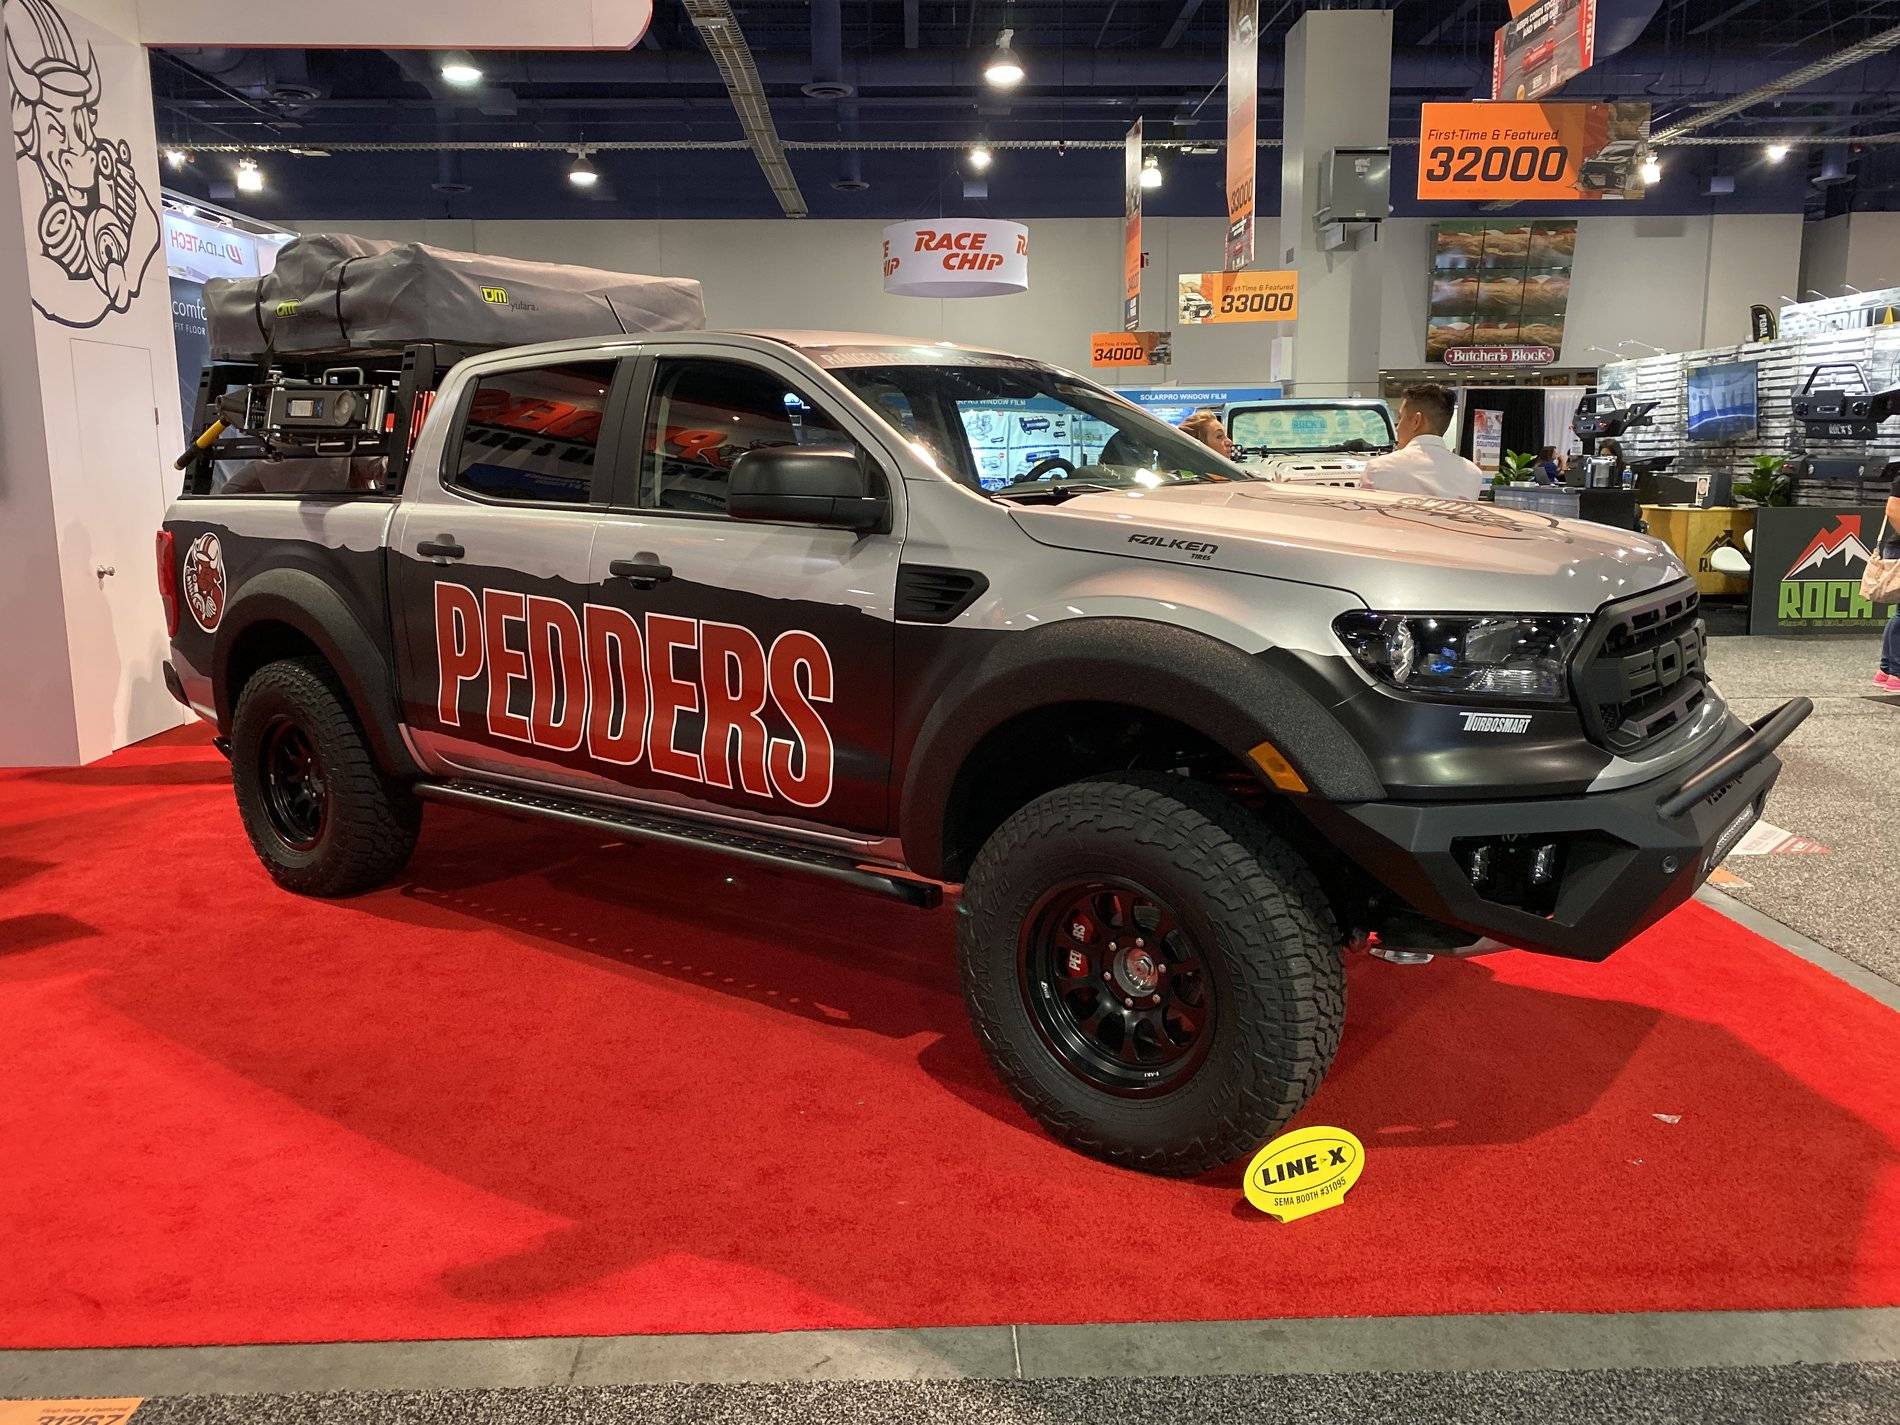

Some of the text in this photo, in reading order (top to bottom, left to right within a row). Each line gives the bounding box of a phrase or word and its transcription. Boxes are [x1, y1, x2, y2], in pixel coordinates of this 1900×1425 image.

[1428, 129, 1559, 141] First-Time & Featured
[1426, 146, 1568, 182] 32000
[914, 230, 987, 251] RACE
[943, 253, 1003, 270] CHIP
[1264, 283, 1294, 291] Featured
[1221, 292, 1294, 314] 33000
[186, 323, 206, 335] FLOOR
[1094, 347, 1143, 361] 34000
[1453, 349, 1546, 362] Butcher's Block
[1140, 393, 1179, 401] SOLARPRO
[1182, 393, 1210, 401] WINDOW
[1127, 534, 1219, 555] FALKEN
[1191, 553, 1211, 561] TIRES
[434, 580, 834, 808] PEDDERS
[1459, 712, 1532, 734] TURBOSMART
[1274, 1176, 1346, 1207] SEMA BOOTH #31095
